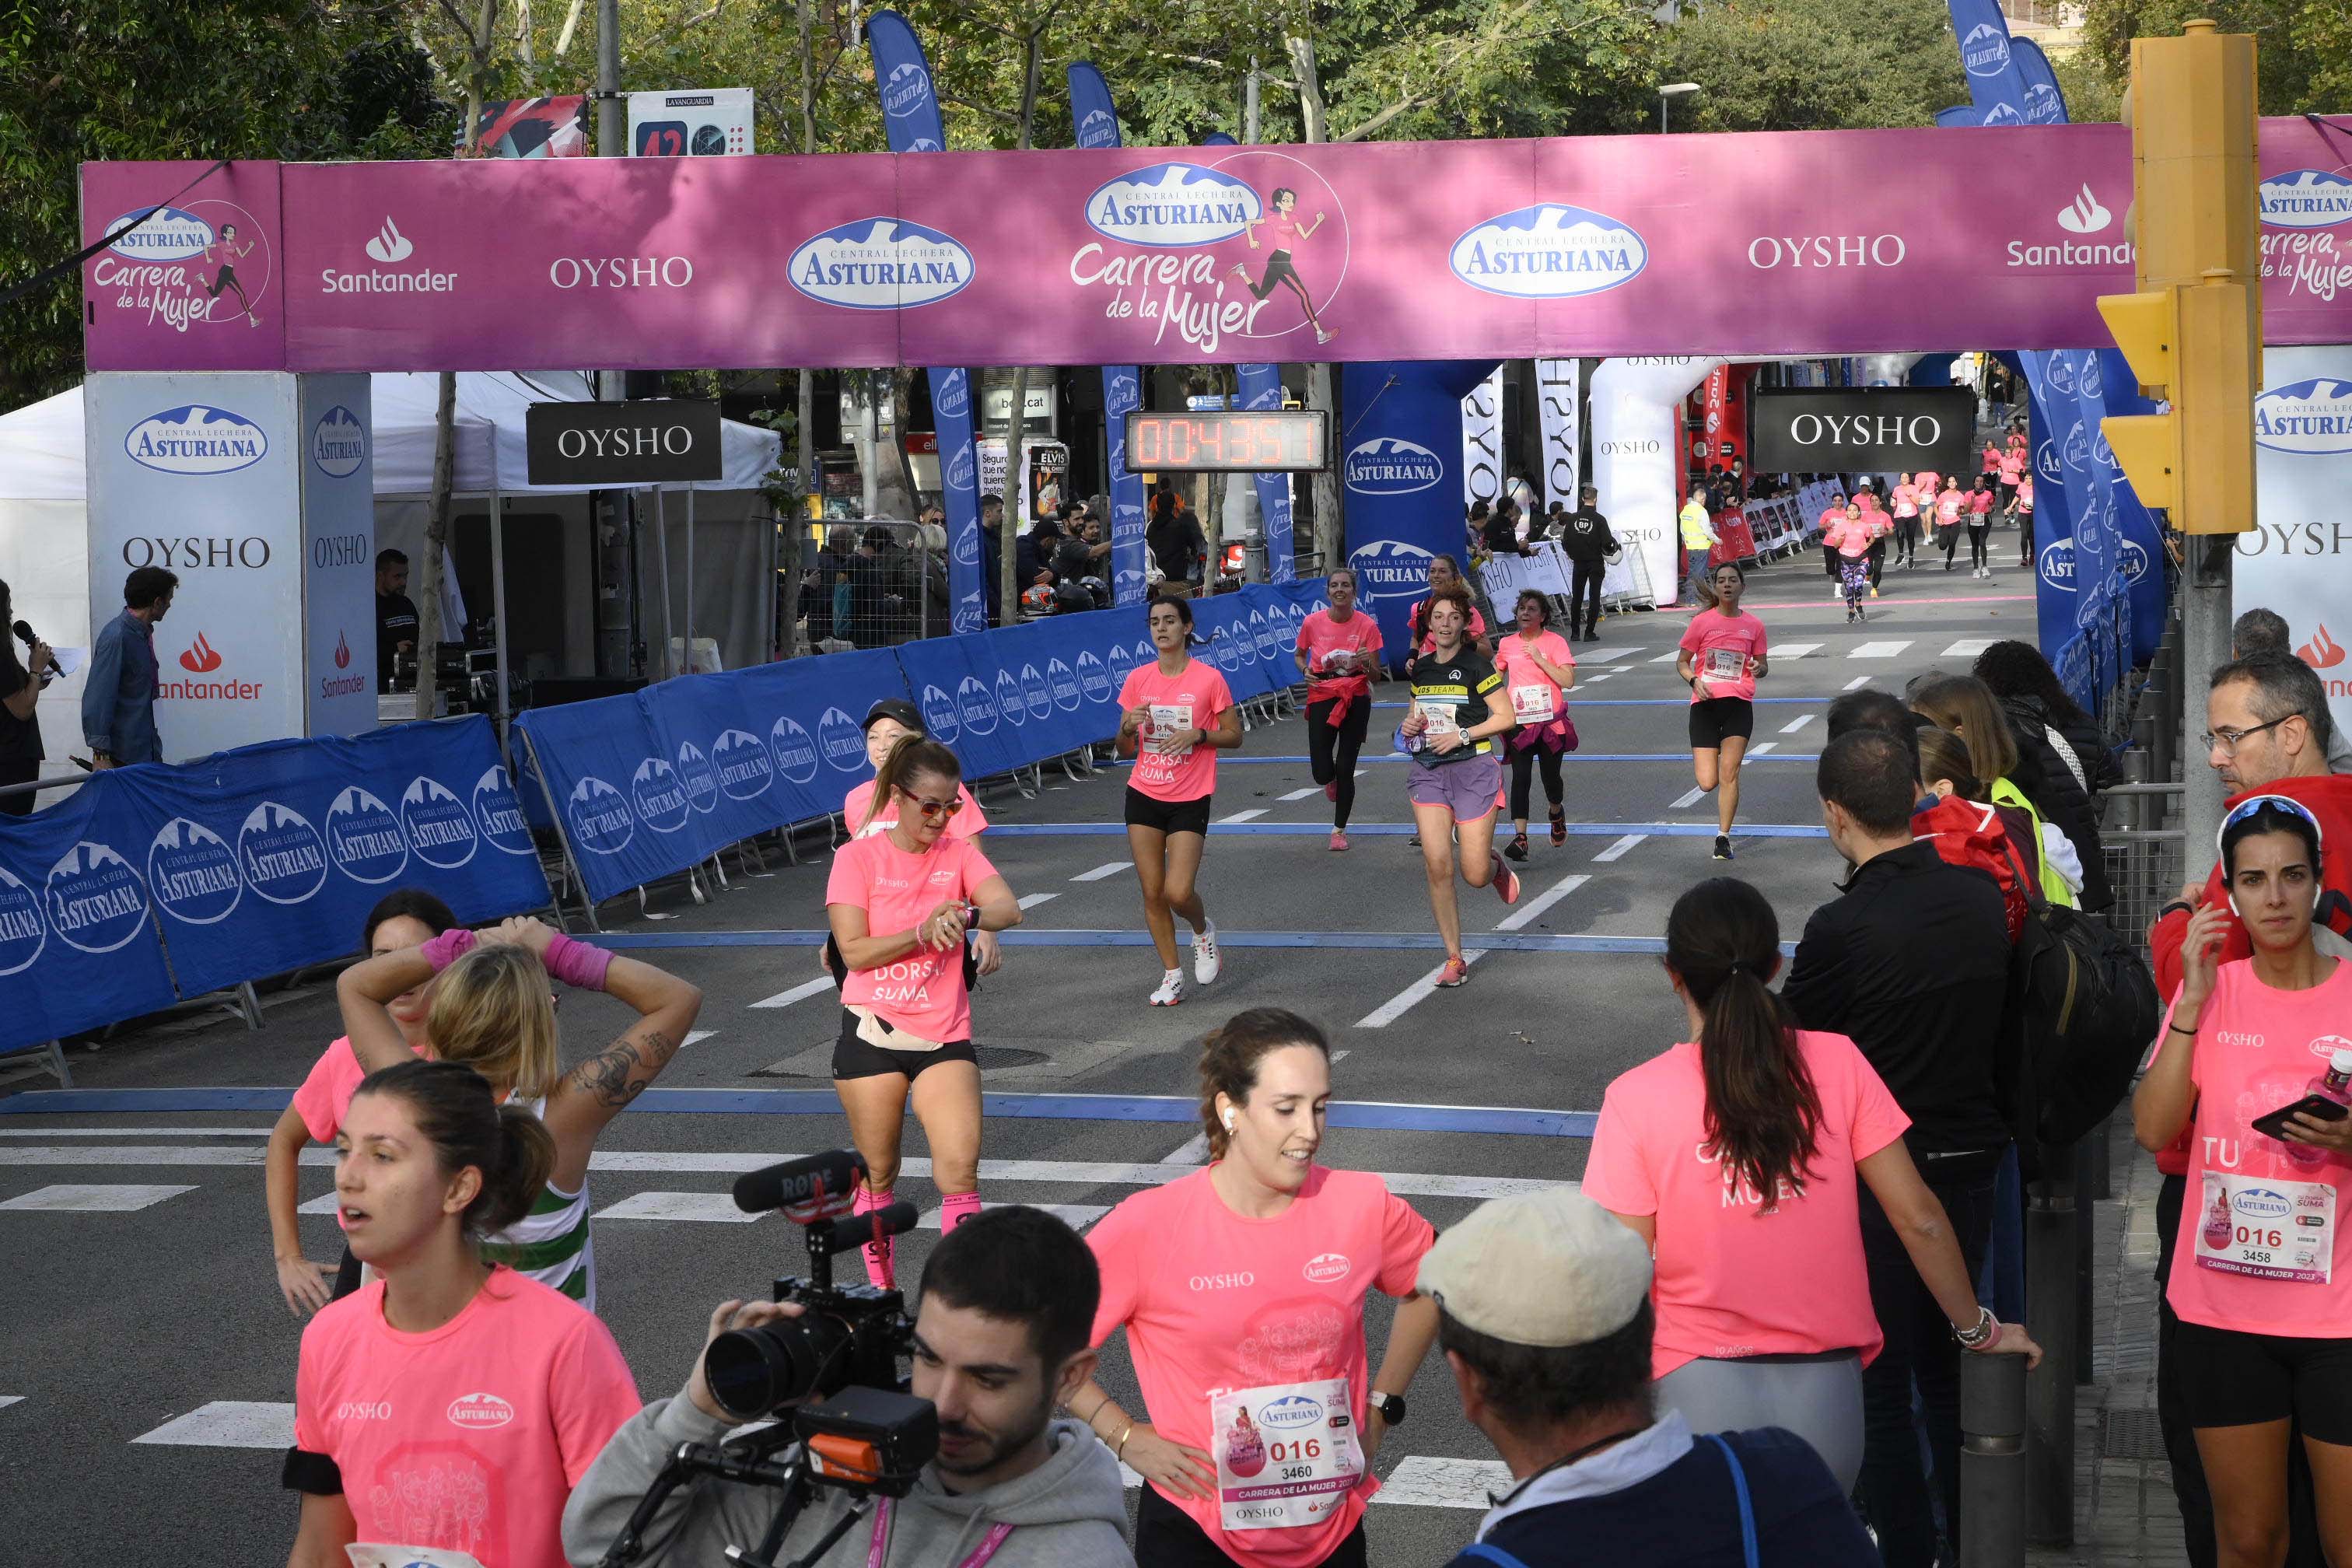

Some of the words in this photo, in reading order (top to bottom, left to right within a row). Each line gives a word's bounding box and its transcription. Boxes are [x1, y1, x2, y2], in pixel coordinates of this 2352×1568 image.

[1187, 191, 1243, 199] LECHERA
[1098, 194, 1248, 226] ASTURIANA
[830, 250, 890, 258] CENTRAL
[894, 248, 954, 257] LECHERA
[1495, 237, 1557, 247] CENTRAL
[1748, 234, 1906, 268] OYSHO
[2260, 233, 2334, 254] arrera
[802, 252, 960, 285] ASTURIANA
[1070, 243, 1216, 286] Carrera
[1465, 240, 1633, 275] ASTURIANA
[94, 257, 186, 287] Carrera
[322, 268, 458, 292] Santander
[549, 257, 693, 289] OYSHO
[2279, 256, 2292, 277] la
[2288, 250, 2352, 302] Muje
[117, 288, 134, 308] de
[137, 288, 149, 308] la
[148, 284, 220, 332] Mujer
[1106, 288, 1132, 318] de
[1139, 288, 1157, 318] la
[1154, 281, 1269, 353] Mujer
[2277, 404, 2329, 413] CENTRAL
[557, 425, 692, 458] OYSHO
[1790, 414, 1941, 446] OYSHO
[136, 431, 257, 457] ASTURIANA
[317, 433, 362, 460] ASTURIANA
[1601, 439, 1660, 455] OYSHO
[1041, 453, 1065, 464] ELVIS
[983, 467, 996, 476] que
[1348, 461, 1436, 482] ASTURIANA
[314, 534, 367, 569] OYSHO
[2234, 522, 2352, 557] OYSH
[123, 537, 271, 569] OYSHO
[159, 679, 263, 700] antander
[322, 674, 365, 699] Santander
[1486, 676, 1497, 685] AOS
[822, 733, 865, 758] ASTURIANA
[775, 747, 815, 769] ASTURIANA
[716, 756, 771, 786] ASTURIANA
[638, 787, 686, 819] ASTURIAN
[334, 827, 404, 863] ASTURIANA
[408, 817, 474, 849] ASTURIANA
[246, 845, 324, 884] ASTURIANA
[158, 863, 238, 903] ASTURIANA
[872, 984, 929, 1002] SUMA
[2202, 1136, 2240, 1167] TU
[1722, 1179, 1807, 1208] MUER
[2236, 1198, 2287, 1213] ASTURIANA
[2297, 1199, 2324, 1208] SUMA
[2236, 1226, 2283, 1248] 016
[2242, 1250, 2271, 1264] 3458
[1189, 1272, 1255, 1291] OYSHO
[1306, 1261, 1348, 1279] ASTURIANA
[2207, 1260, 2240, 1272] CARRERA
[2265, 1269, 2294, 1279] MUJER
[2296, 1272, 2315, 1281] 2023
[1727, 1345, 1753, 1355] AÑOS
[338, 1401, 392, 1420] OYSHO
[452, 1405, 508, 1420] ASTURIANA
[1265, 1409, 1318, 1423] ASTURIANA
[1270, 1438, 1321, 1462] 016
[1282, 1465, 1312, 1479] 3460
[1238, 1489, 1280, 1499] CARRERA
[1309, 1482, 1336, 1492] MUJER
[1236, 1507, 1283, 1519] OYSHO
